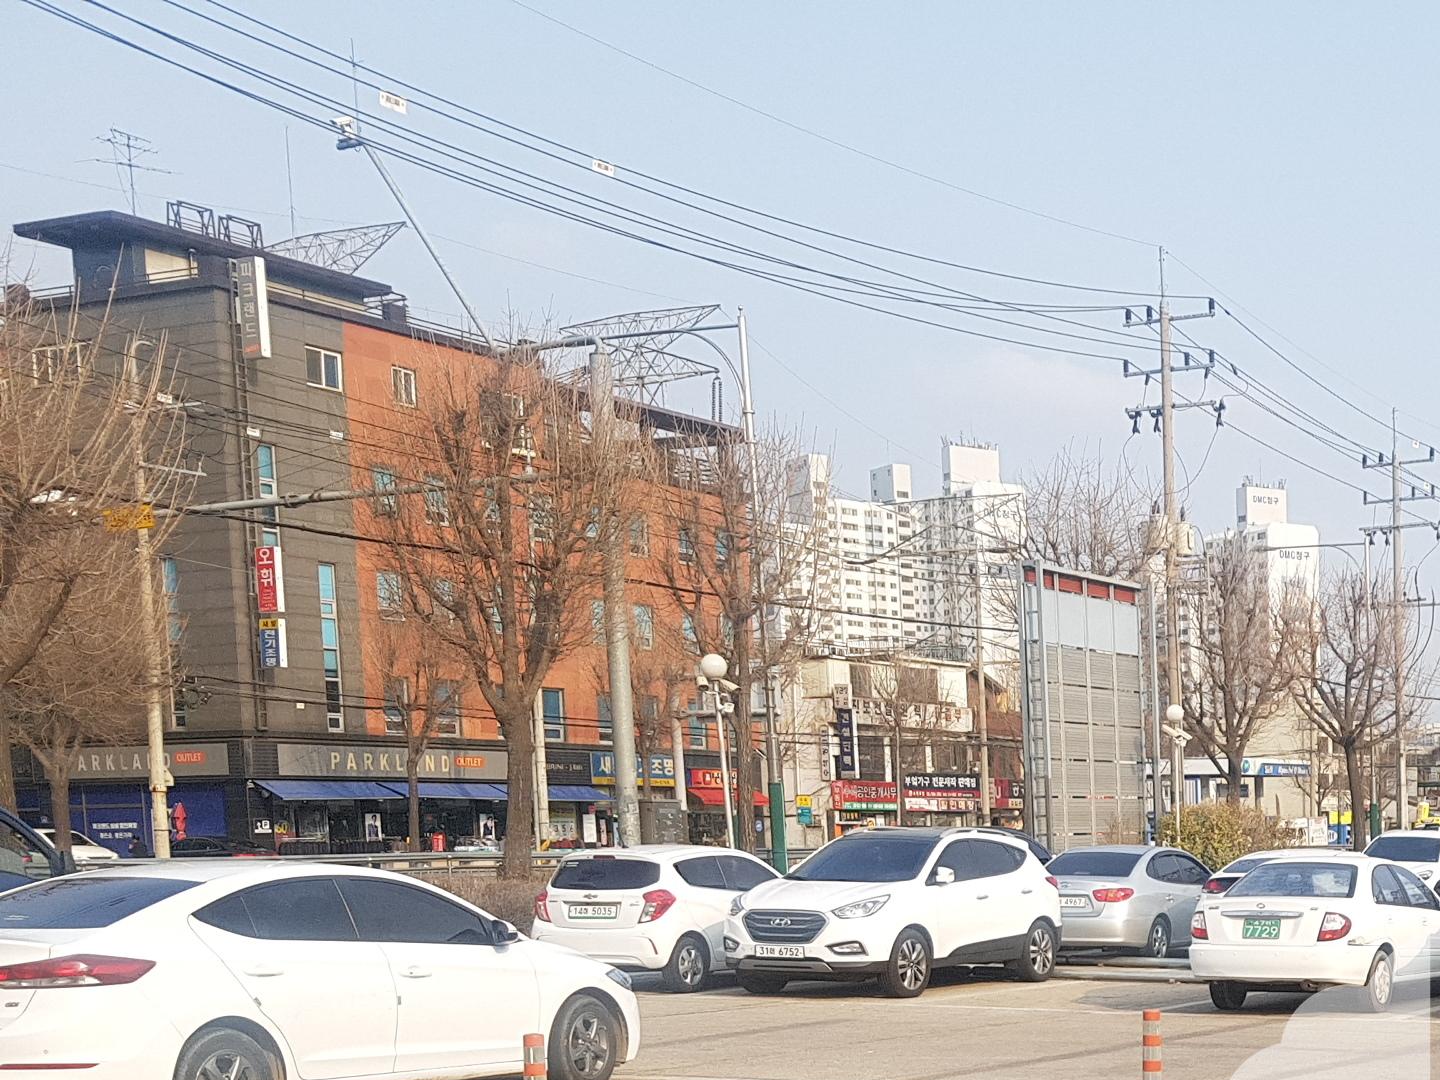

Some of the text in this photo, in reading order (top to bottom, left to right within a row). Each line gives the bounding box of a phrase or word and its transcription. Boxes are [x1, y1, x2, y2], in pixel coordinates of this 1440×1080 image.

[176, 752, 201, 762] OUTLET
[331, 751, 449, 772] PARKLND
[456, 757, 482, 767] OUTLET
[1064, 897, 1082, 906] 4967
[592, 906, 613, 916] 5035
[1245, 925, 1279, 937] 7729
[778, 946, 800, 957] 6752
